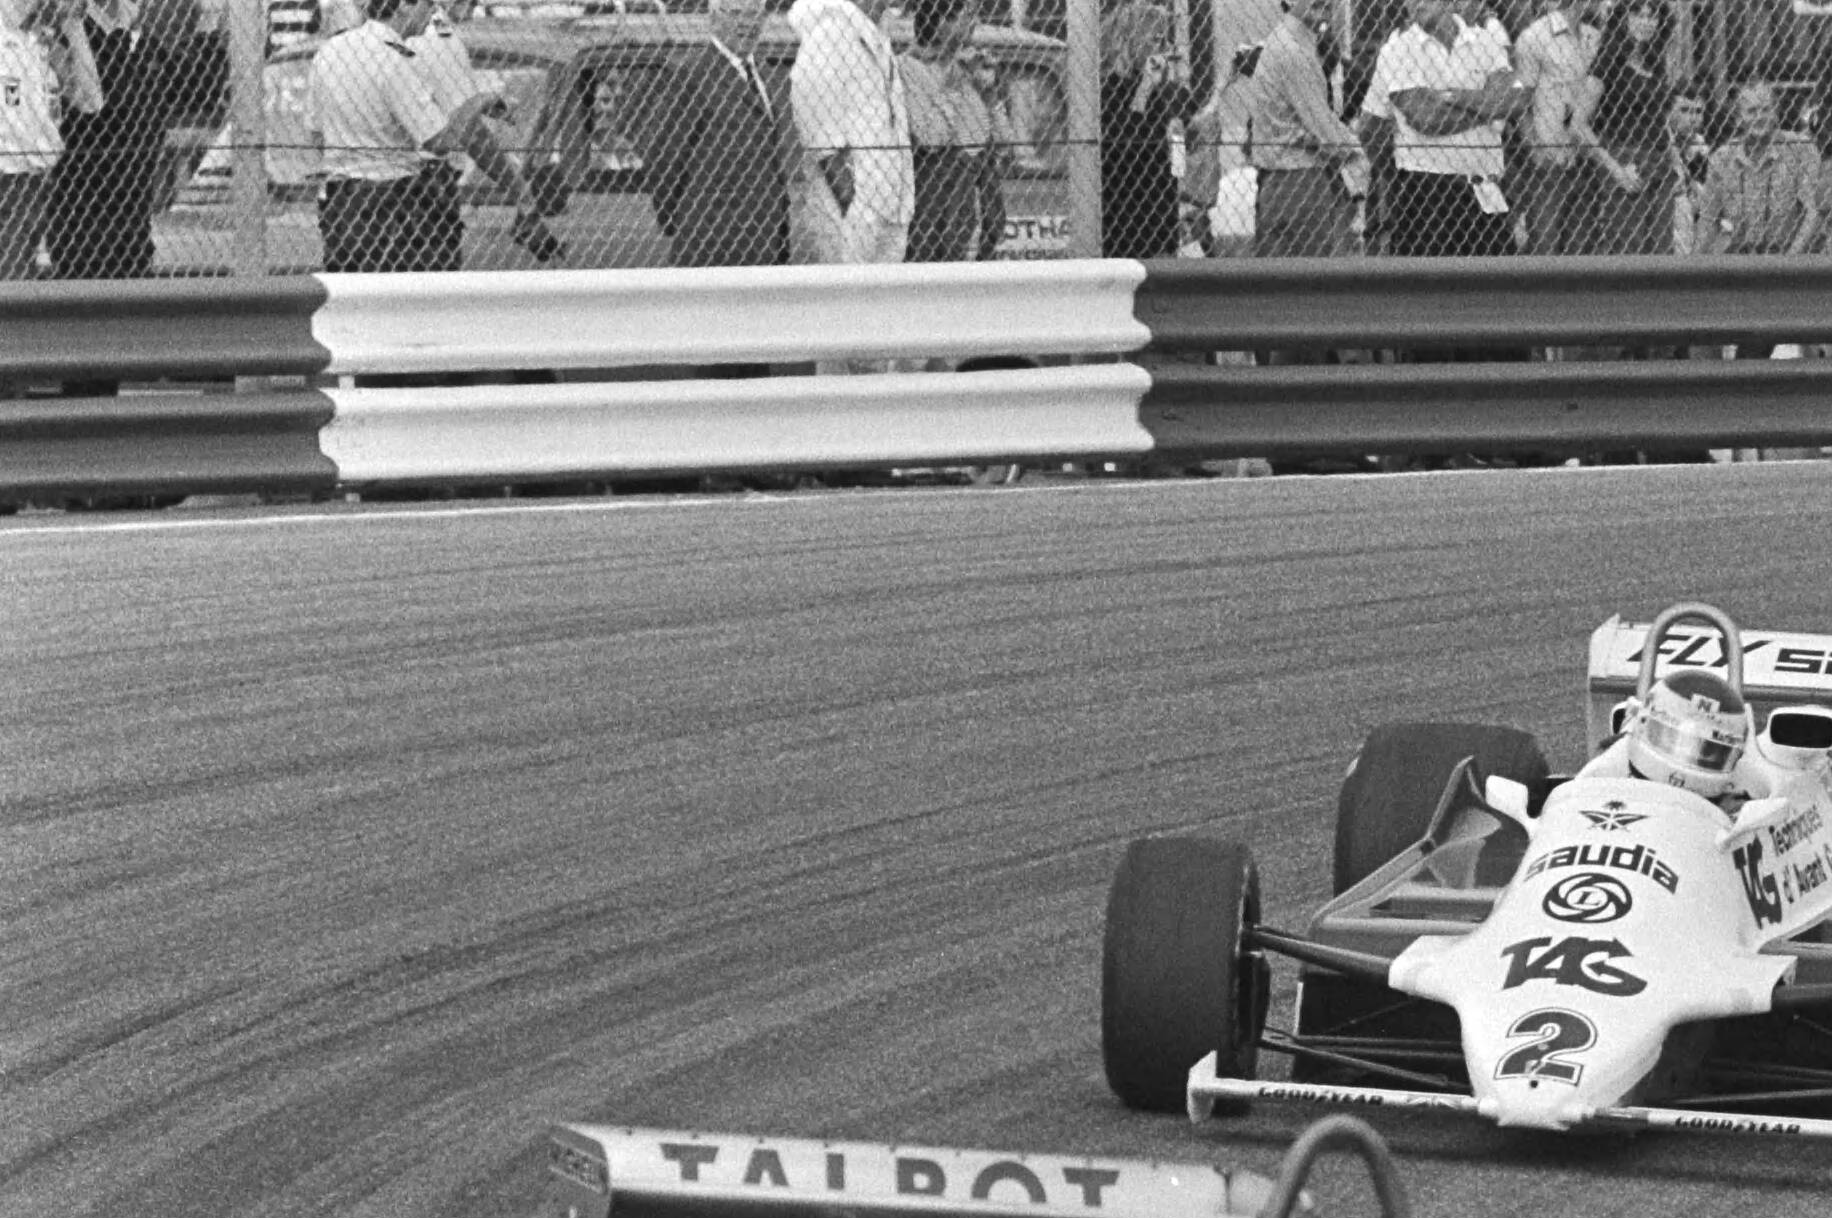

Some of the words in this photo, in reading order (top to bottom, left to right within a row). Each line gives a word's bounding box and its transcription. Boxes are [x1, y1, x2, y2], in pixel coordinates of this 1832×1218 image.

[1523, 844, 1679, 896] saudia
[1732, 834, 1783, 930] TAG
[1500, 936, 1648, 997] TAG
[1494, 1006, 1598, 1087] 2
